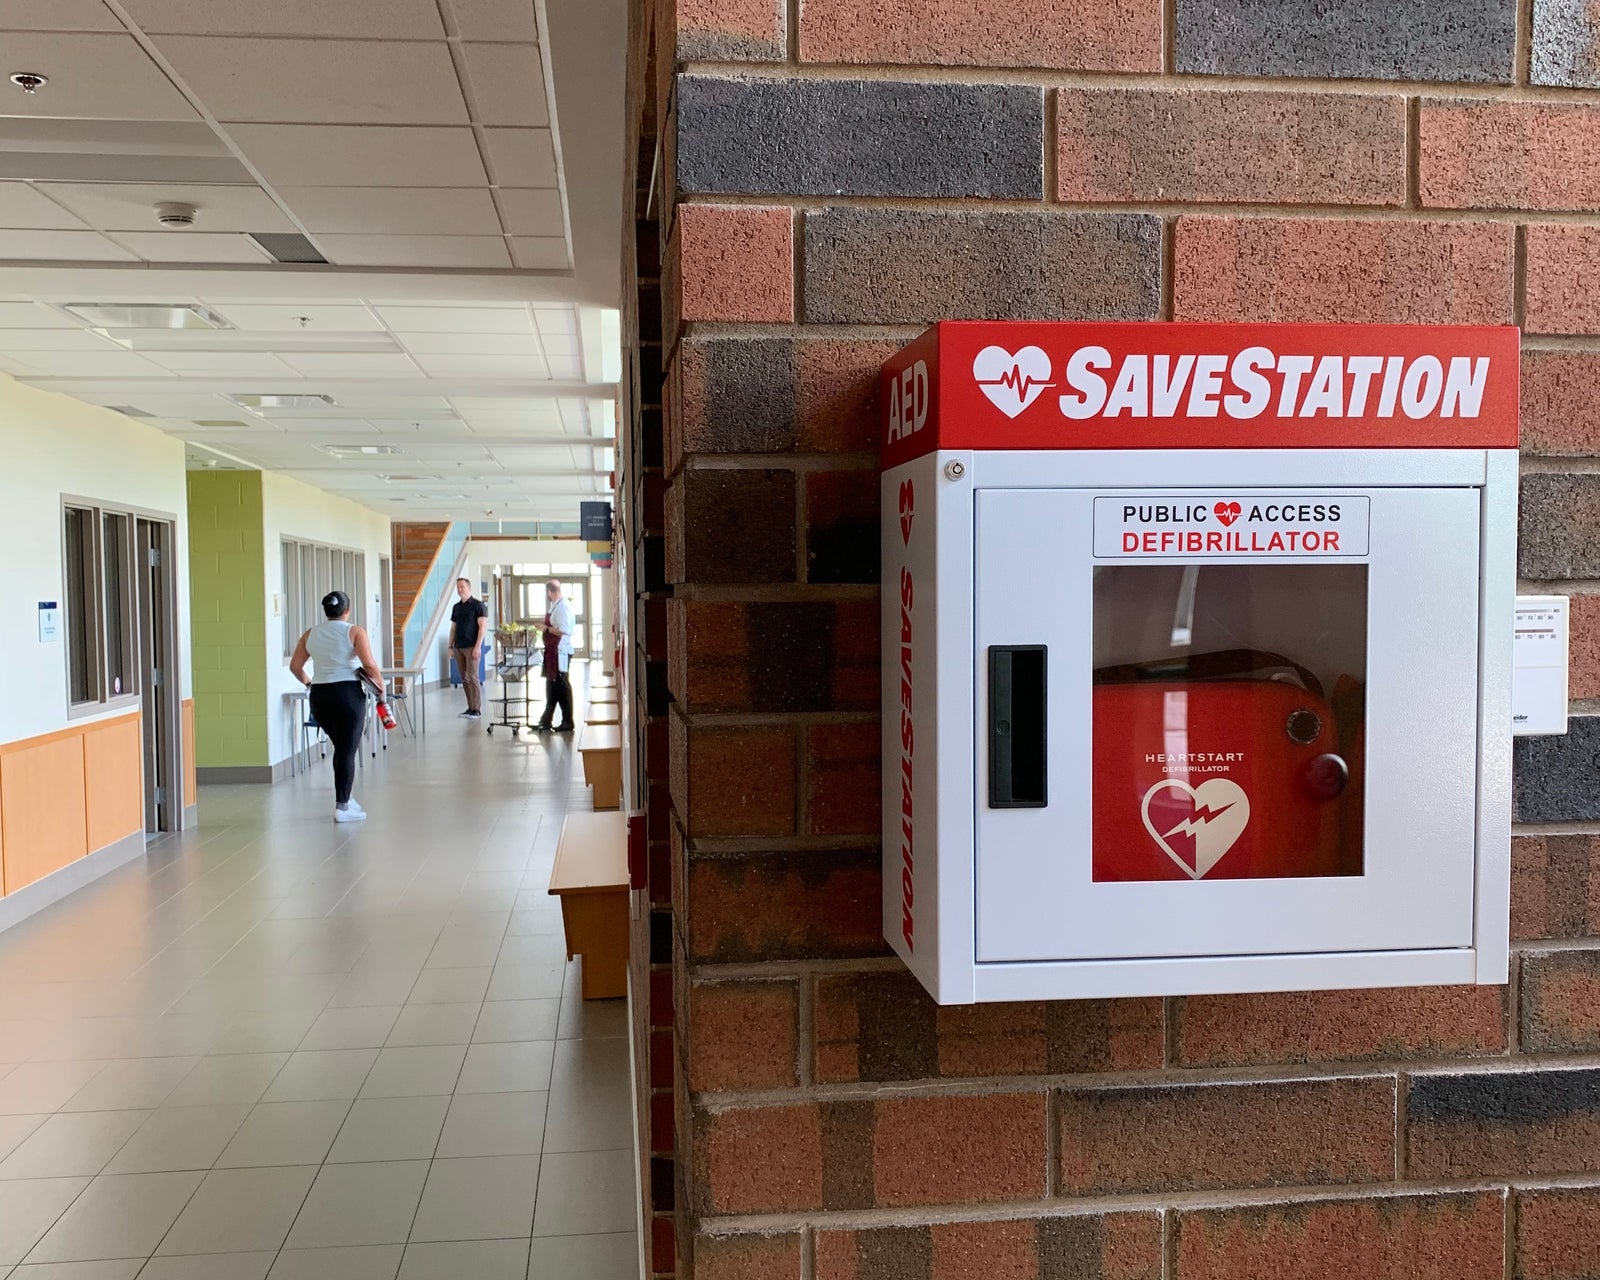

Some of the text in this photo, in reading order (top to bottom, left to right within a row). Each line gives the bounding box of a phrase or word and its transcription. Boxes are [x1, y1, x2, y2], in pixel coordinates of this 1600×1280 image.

[887, 359, 929, 445] AED
[1123, 504, 1341, 523] PUBLIC ACCESS
[1122, 530, 1341, 553] DEFIBRILLATOR
[1145, 752, 1245, 763] HEARTSTART
[1161, 765, 1230, 773] DEFIBRILLATOR
